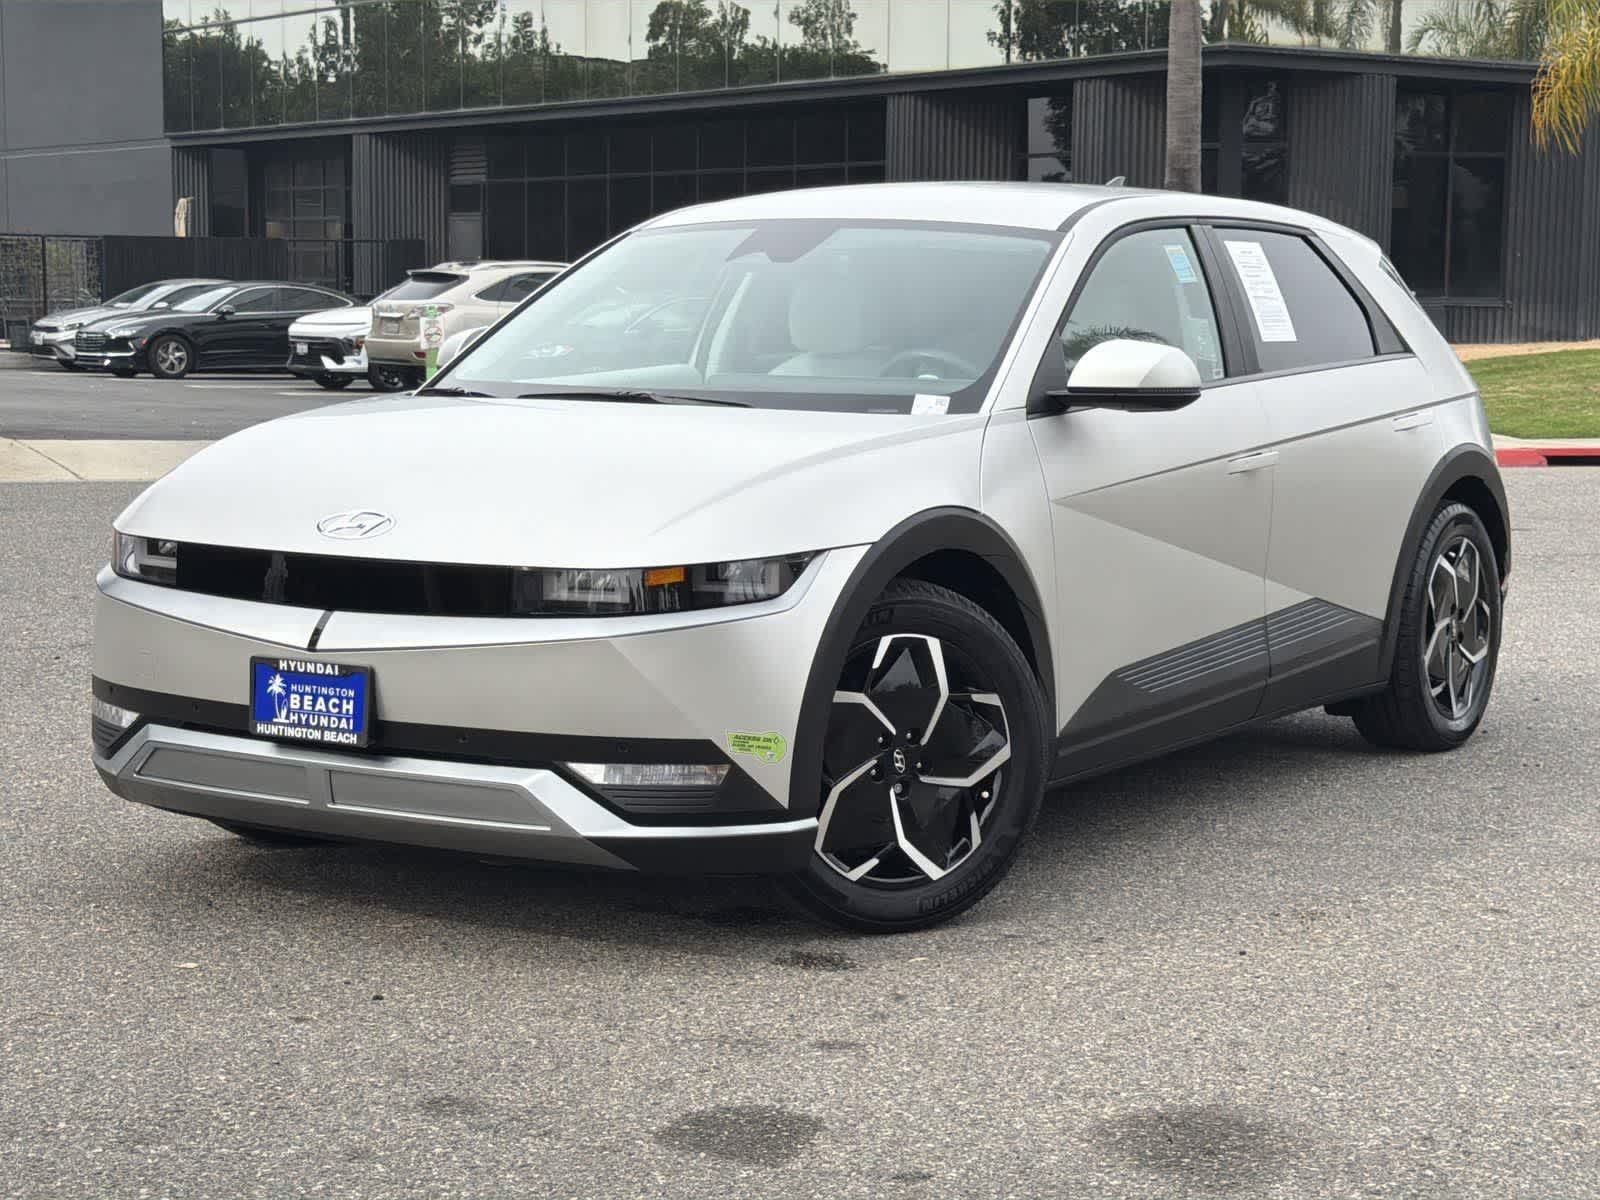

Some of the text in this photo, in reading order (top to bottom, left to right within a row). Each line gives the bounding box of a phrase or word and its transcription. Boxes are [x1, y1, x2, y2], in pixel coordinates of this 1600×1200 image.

[279, 660, 339, 676] HYUNDAI
[290, 683, 355, 698] HUNTINGTON
[289, 693, 354, 715] BEACH
[289, 711, 354, 730] HYUNDAI
[256, 723, 357, 744] HUNTINGTON BEACH
